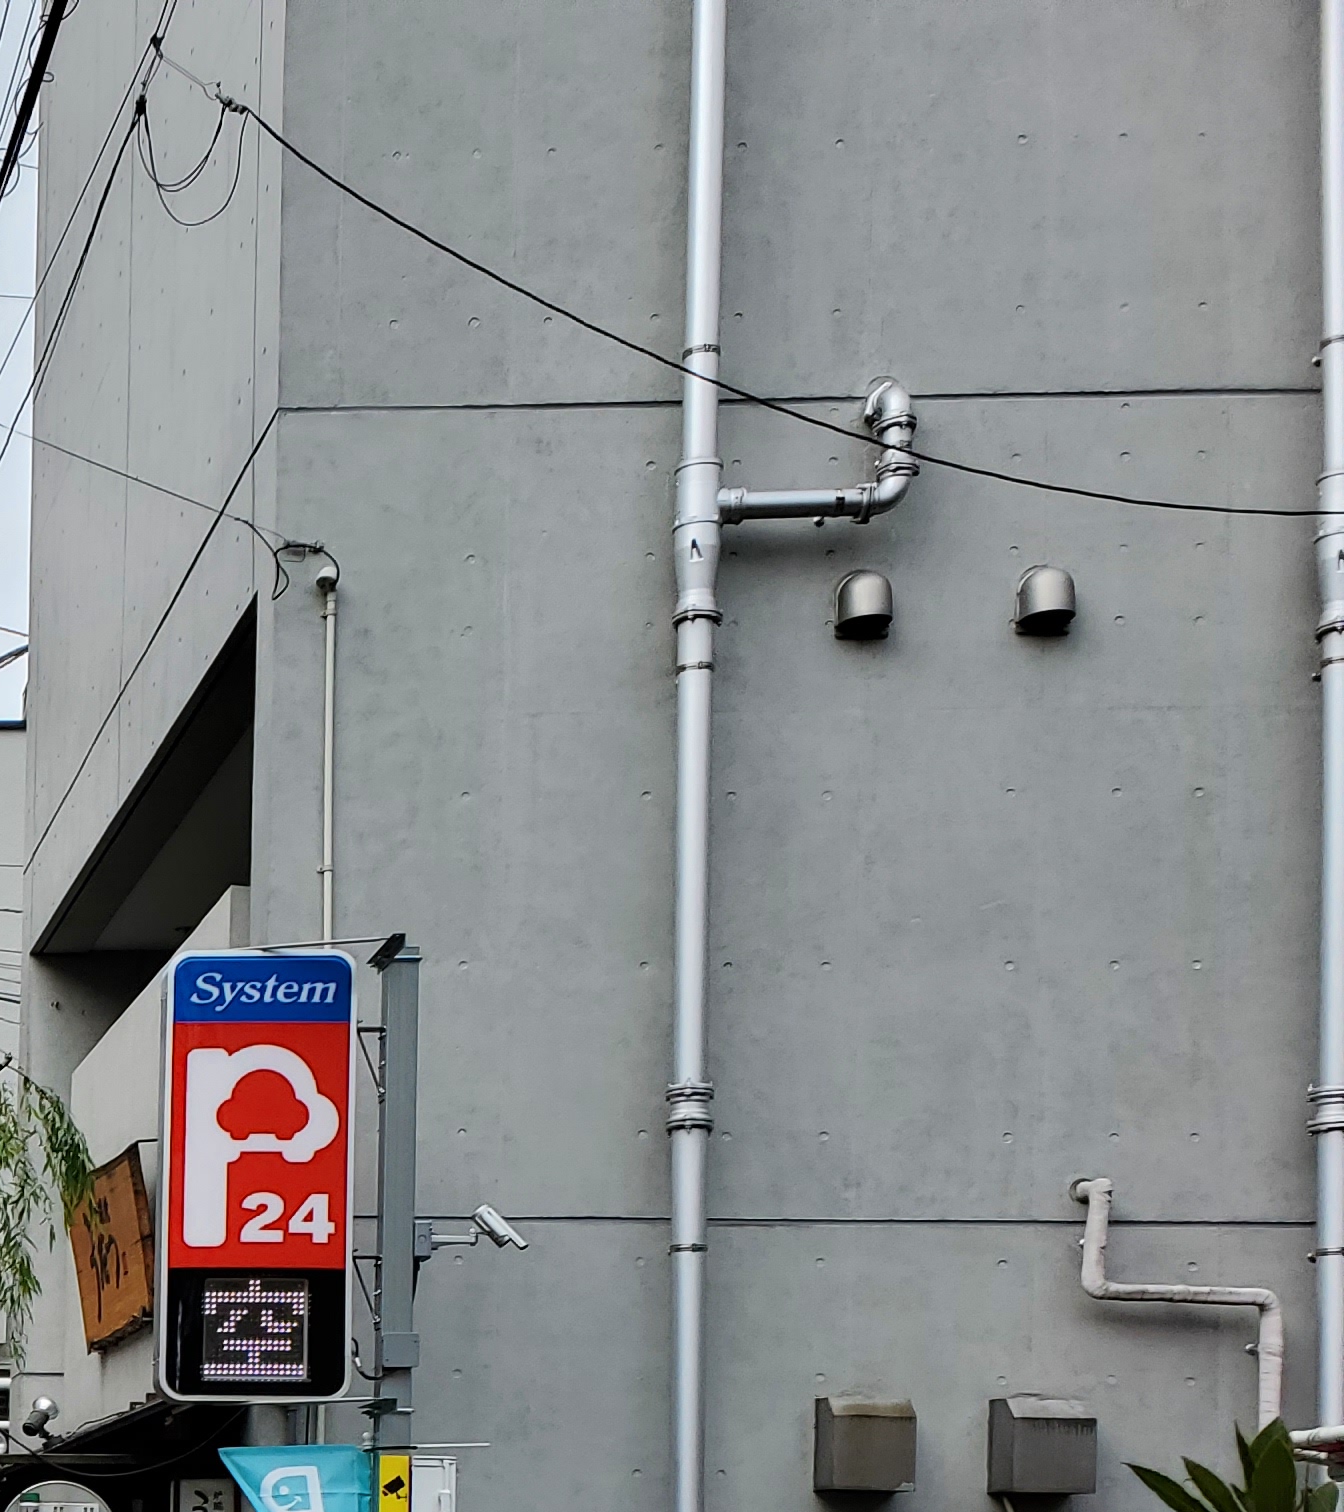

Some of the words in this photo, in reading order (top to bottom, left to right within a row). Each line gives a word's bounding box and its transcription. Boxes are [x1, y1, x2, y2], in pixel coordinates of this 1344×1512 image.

[189, 971, 338, 1012] System
[239, 1191, 336, 1245] 24
[201, 1279, 306, 1378] 空
